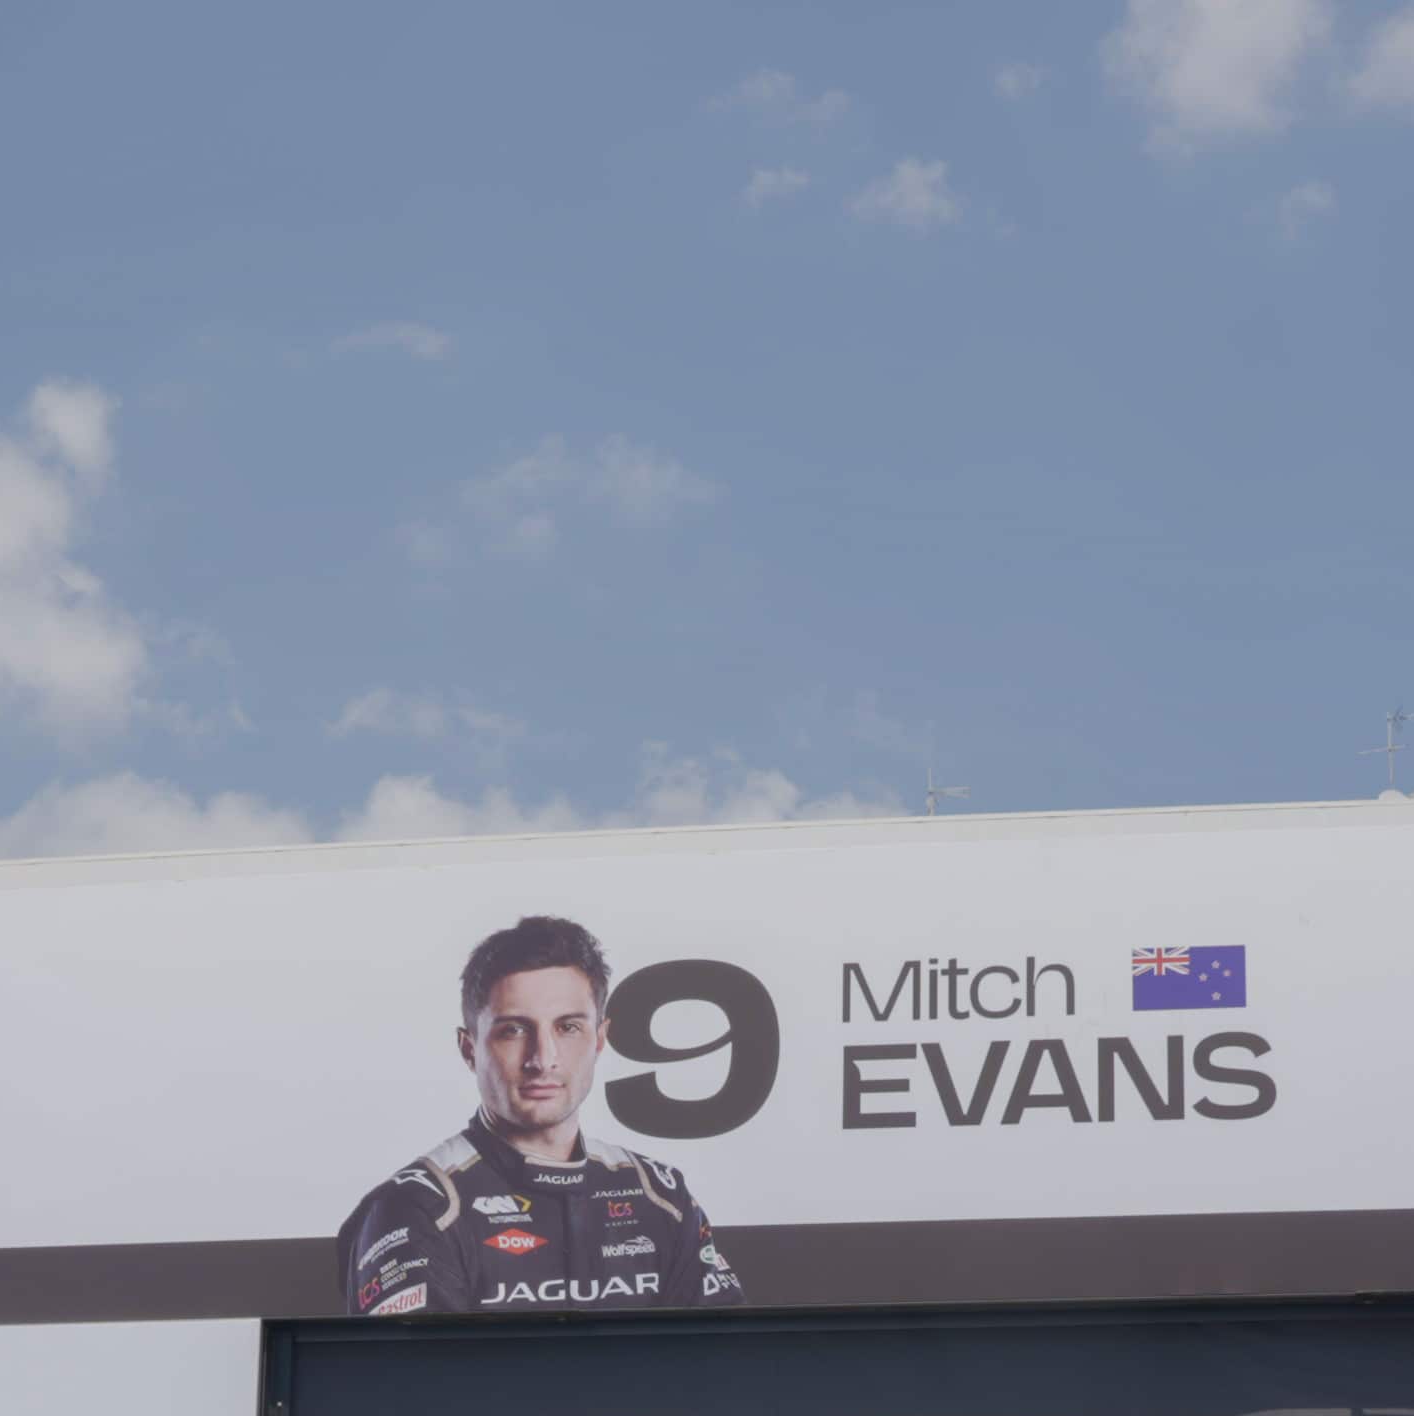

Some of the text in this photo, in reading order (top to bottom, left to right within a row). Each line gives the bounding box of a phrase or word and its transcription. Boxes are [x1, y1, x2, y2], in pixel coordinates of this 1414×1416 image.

[842, 956, 1076, 1023] Mitch
[604, 959, 780, 1139] 9
[842, 1031, 1277, 1129] EVANS
[591, 1188, 644, 1199] JAGUAR
[480, 1272, 660, 1304] JAGUAR
